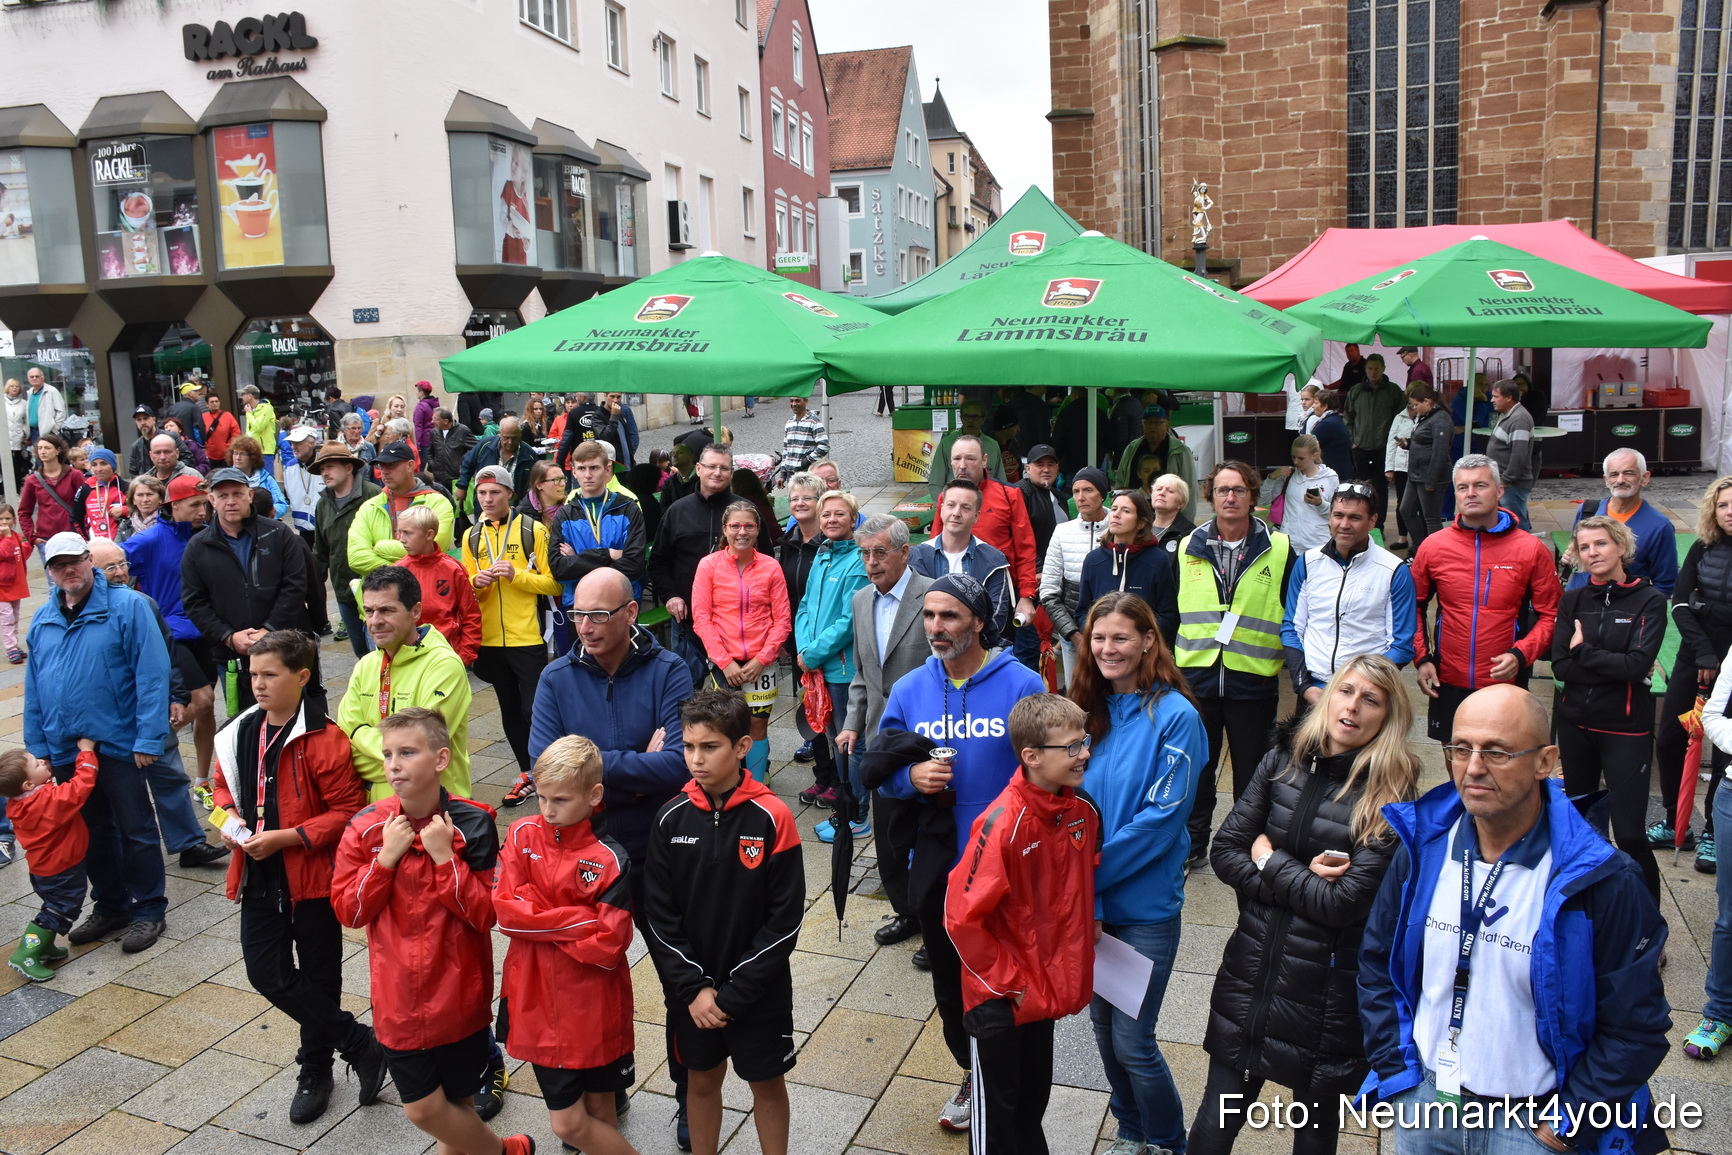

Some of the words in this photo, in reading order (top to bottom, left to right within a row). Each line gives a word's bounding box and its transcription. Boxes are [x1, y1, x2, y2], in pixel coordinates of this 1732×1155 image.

[182, 11, 318, 61] RACKL
[206, 68, 233, 81] am
[236, 56, 308, 77] Rathaus
[97, 146, 112, 158] 100
[113, 142, 137, 157] Jahre
[94, 157, 134, 181] RACKL
[871, 188, 886, 277] satzke
[1478, 296, 1576, 306] Neumarkter
[1465, 304, 1604, 317] Lammsbräu
[991, 315, 1129, 327] Neumarkter
[586, 327, 701, 338] Neumarkter
[957, 326, 1148, 343] Lammsbräu
[271, 337, 298, 353] RACKL
[553, 338, 711, 353] Lammsbräu
[36, 348, 61, 362] RACKL
[914, 712, 1006, 740] adidas
[670, 835, 699, 845] saller
[745, 845, 760, 858] ASV
[1478, 860, 1503, 908] www.kind.com
[1424, 915, 1460, 934] Chanc
[1500, 935, 1532, 955] Gren
[1461, 933, 1475, 956] KIND
[1453, 997, 1463, 1020] KIND
